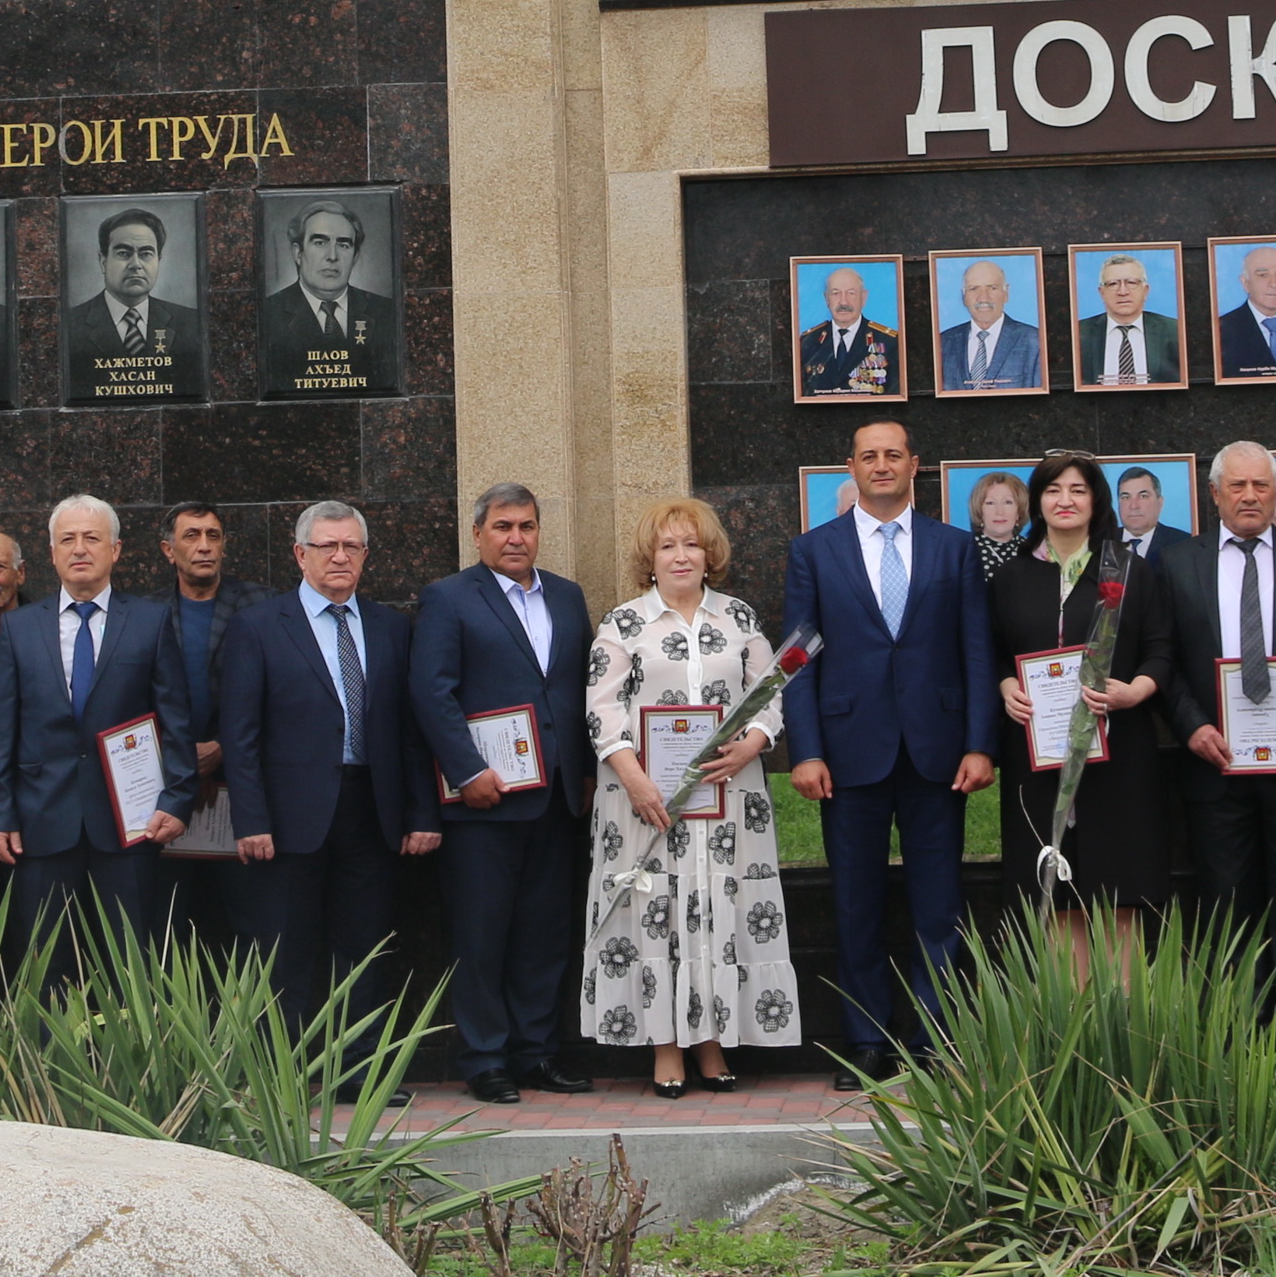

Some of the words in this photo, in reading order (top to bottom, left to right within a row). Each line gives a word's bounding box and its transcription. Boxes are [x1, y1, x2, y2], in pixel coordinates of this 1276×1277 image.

[138, 112, 295, 170] ТРУДА
[307, 350, 349, 361] ШАОВ
[94, 356, 173, 369] ХАЖМЕТОВ
[305, 363, 352, 375] АХЪЕД
[109, 370, 156, 382] ХАСАН
[294, 377, 368, 389] ТИТУЕВИЧ
[95, 384, 174, 396] КУШХОВИЧ
